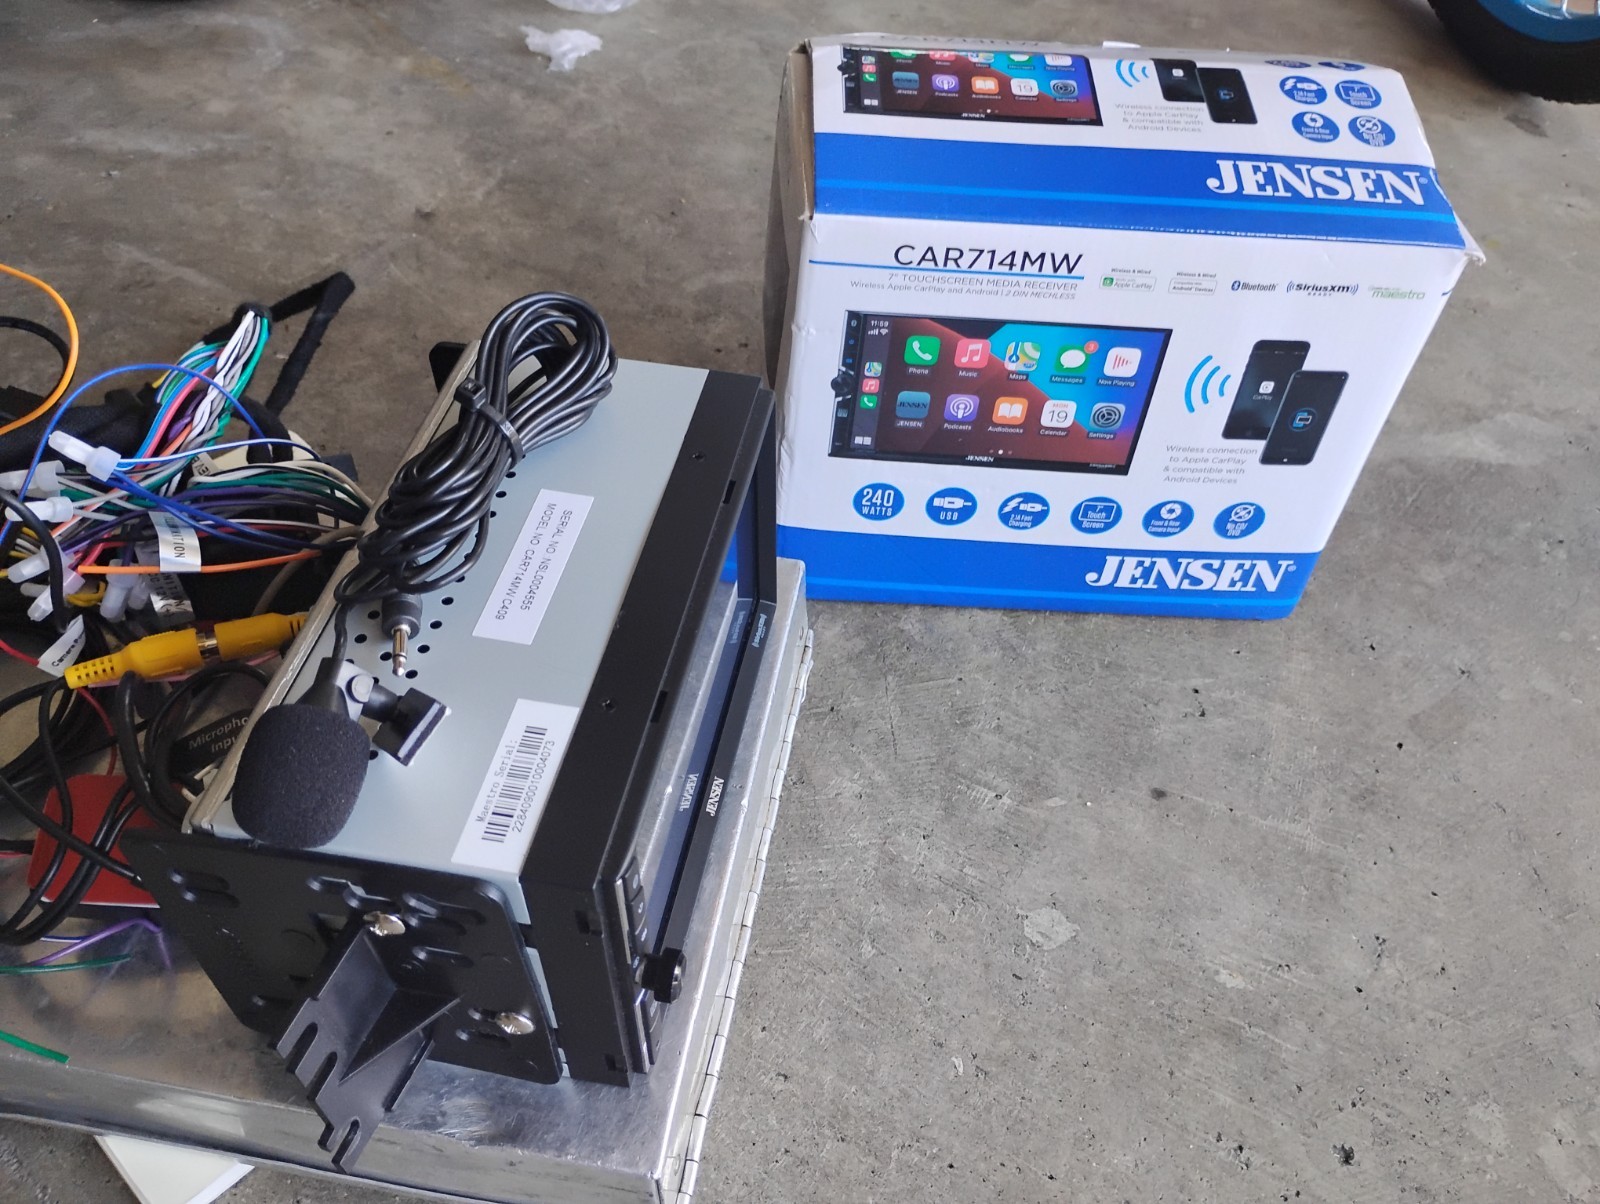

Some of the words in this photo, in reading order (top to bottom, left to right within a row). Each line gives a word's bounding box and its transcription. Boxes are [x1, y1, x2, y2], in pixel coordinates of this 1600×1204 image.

[894, 244, 1083, 274] CAR714MW
[850, 280, 885, 289] Wireless
[887, 283, 911, 291] Apple
[914, 285, 945, 294] CarPlay
[965, 288, 998, 296] Android
[1030, 291, 1076, 300] MECHLESS
[902, 274, 984, 286] TOUCHSCREEN
[986, 278, 1021, 288] MEDIA
[1024, 280, 1078, 291] RECEIVER
[1241, 282, 1276, 291] Bluetooth
[1372, 289, 1426, 300] maestro
[1052, 376, 1083, 384] Messages
[1049, 410, 1068, 424] 19
[988, 425, 1023, 433] Audiobooks
[1166, 445, 1204, 454] Wireless
[1182, 456, 1209, 464] Apple
[1211, 457, 1247, 465] CarPlay
[1172, 467, 1224, 475] compatible
[862, 488, 894, 506] 240
[535, 503, 557, 533] MODEL
[862, 506, 892, 516] WATTS
[940, 512, 958, 520] USB
[1087, 511, 1106, 519] Touch
[553, 510, 573, 539] SERIAL
[1082, 520, 1104, 528] Screen
[530, 533, 543, 546] NO
[546, 540, 560, 554] NO
[506, 549, 535, 598] CAR714MW
[520, 557, 552, 611] NSL0004555
[495, 598, 512, 620] C409
[52, 644, 75, 666] Camera
[189, 717, 249, 750] Micropho
[475, 782, 500, 823] Maestro
[494, 740, 518, 778] Serial:
[512, 740, 555, 833] 2284090010004073
[706, 775, 725, 817] JENSEN
